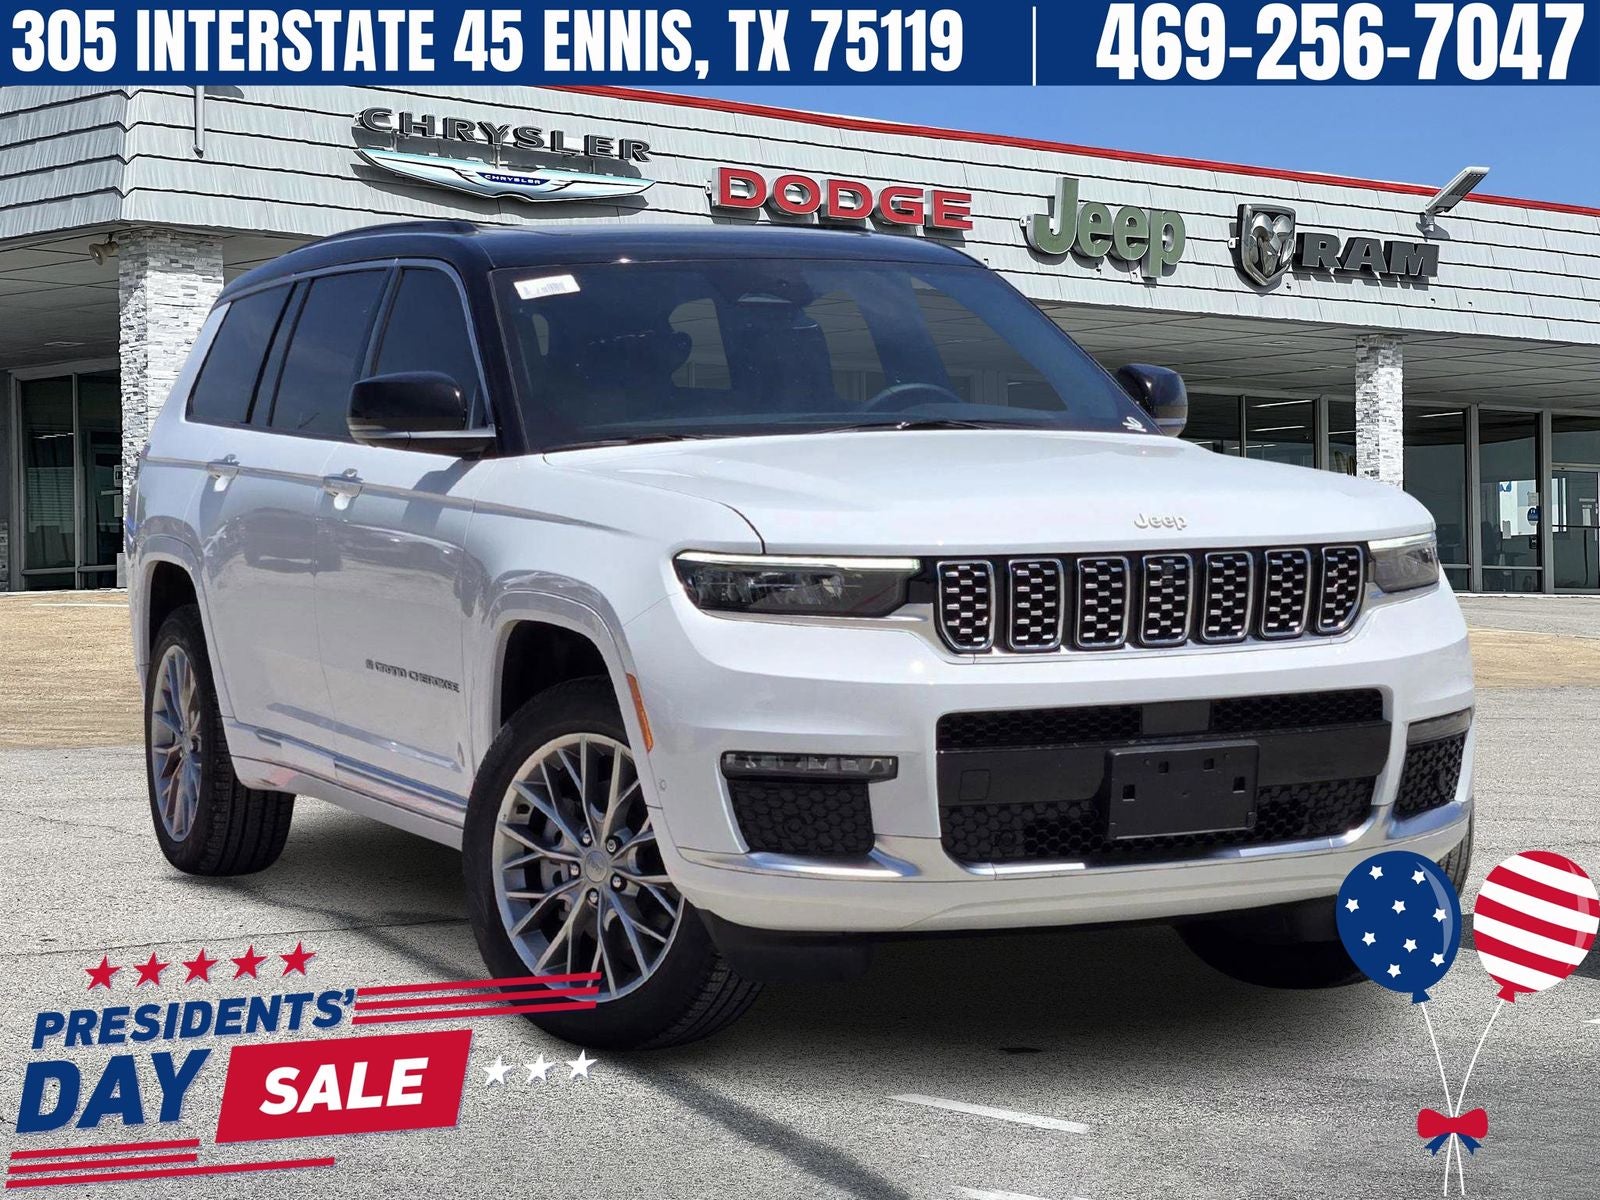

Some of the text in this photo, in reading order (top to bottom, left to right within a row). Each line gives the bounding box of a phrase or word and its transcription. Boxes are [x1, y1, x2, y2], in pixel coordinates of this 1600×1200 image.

[358, 107, 650, 162] CHRYSLER
[714, 167, 973, 230] DODGE
[1028, 177, 1186, 279] Jeep
[1301, 232, 1440, 278] RAM
[1133, 512, 1187, 531] Jeep
